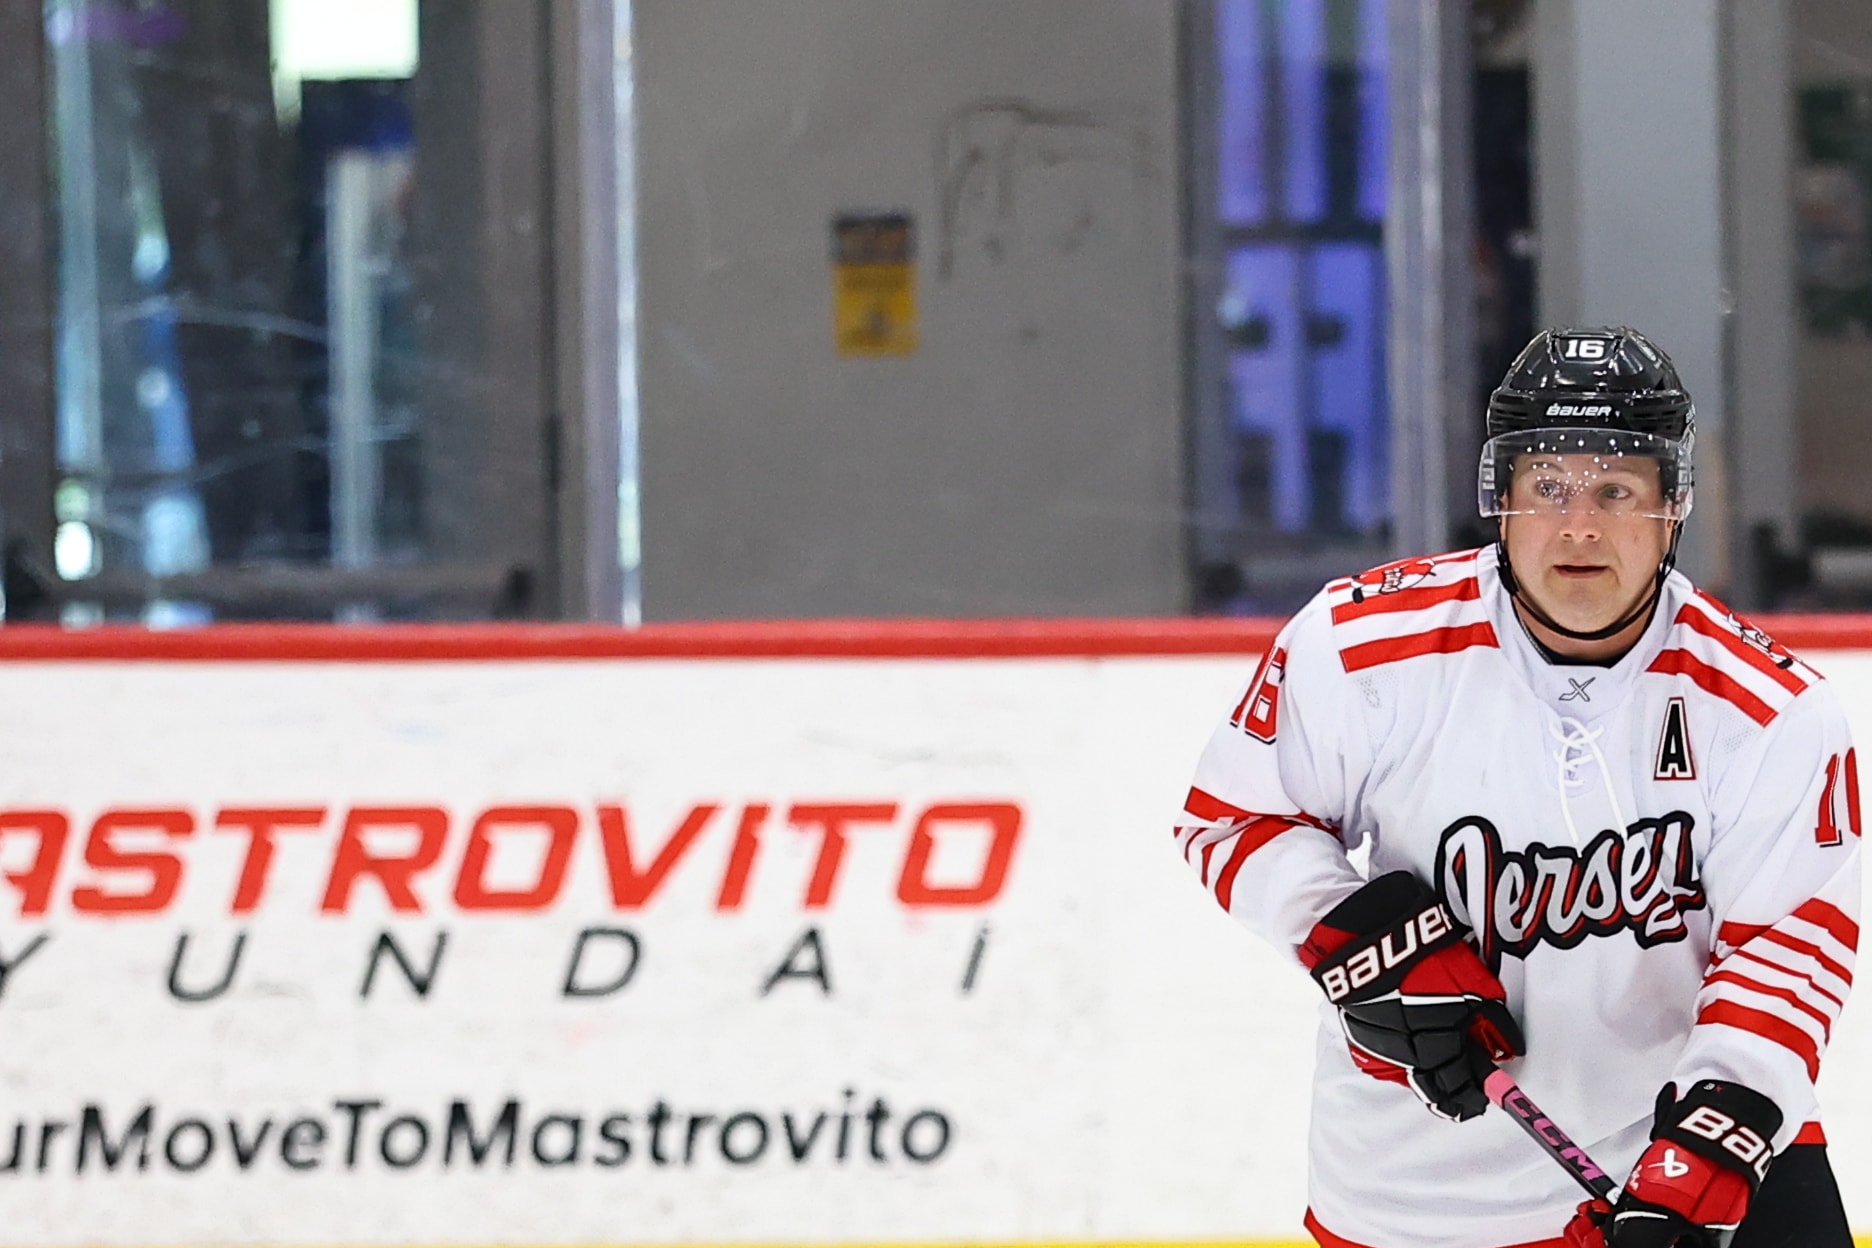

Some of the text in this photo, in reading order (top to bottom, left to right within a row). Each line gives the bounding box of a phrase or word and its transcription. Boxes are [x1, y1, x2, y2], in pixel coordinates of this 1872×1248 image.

[1565, 339, 1605, 359] 16
[1545, 402, 1613, 417] BAUER
[1653, 696, 1697, 781] A
[1435, 810, 1708, 985] Jersey
[1502, 1086, 1605, 1182] CCM
